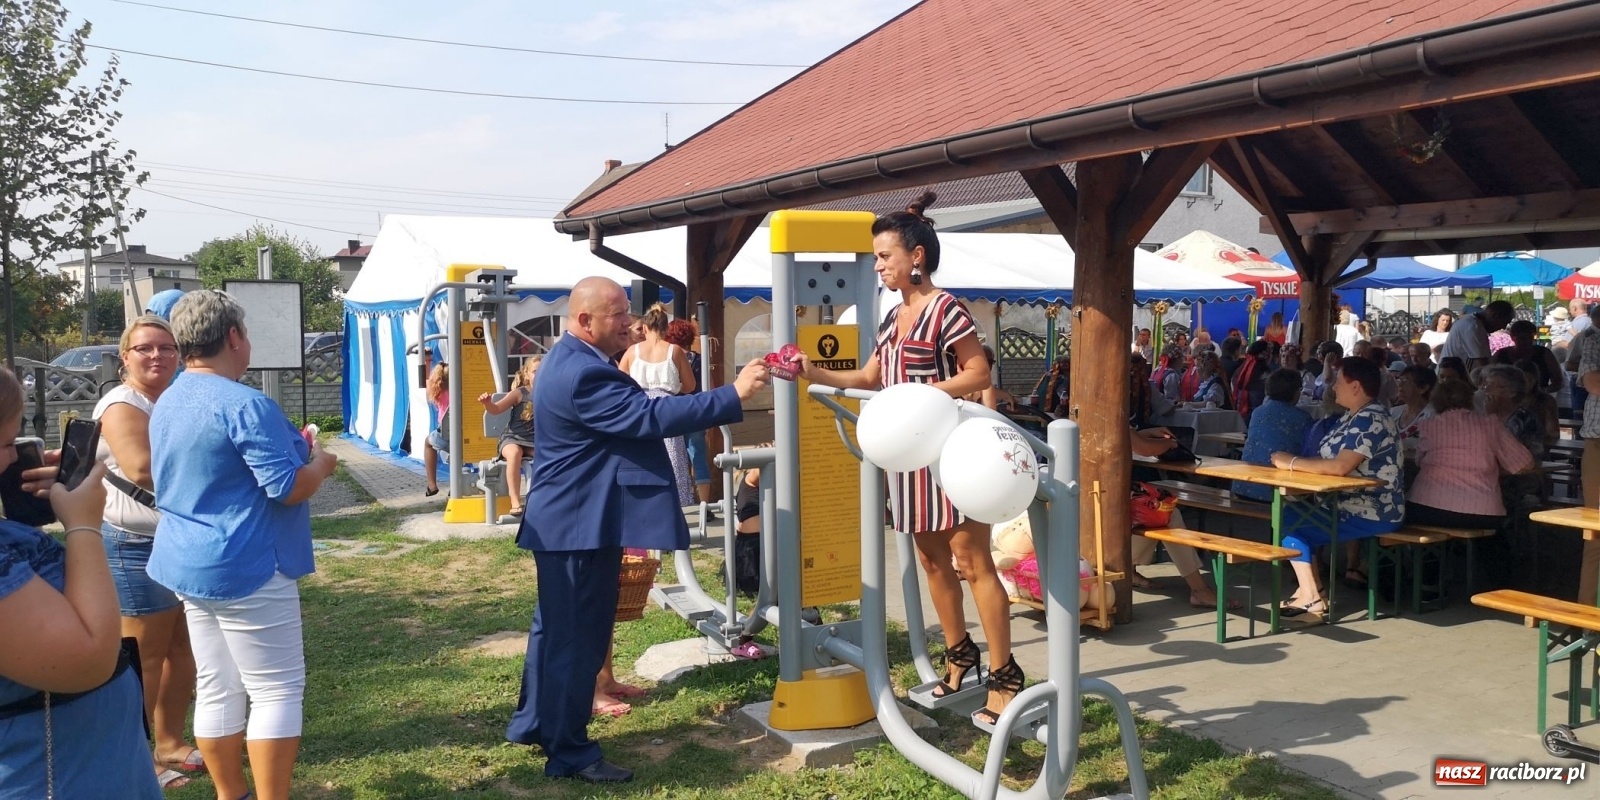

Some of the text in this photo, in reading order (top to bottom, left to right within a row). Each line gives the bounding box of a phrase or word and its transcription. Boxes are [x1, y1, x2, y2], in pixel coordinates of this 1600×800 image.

[1260, 281, 1298, 295] TYSKIE
[1573, 282, 1600, 299] TYSK
[811, 360, 854, 369] ERKULES
